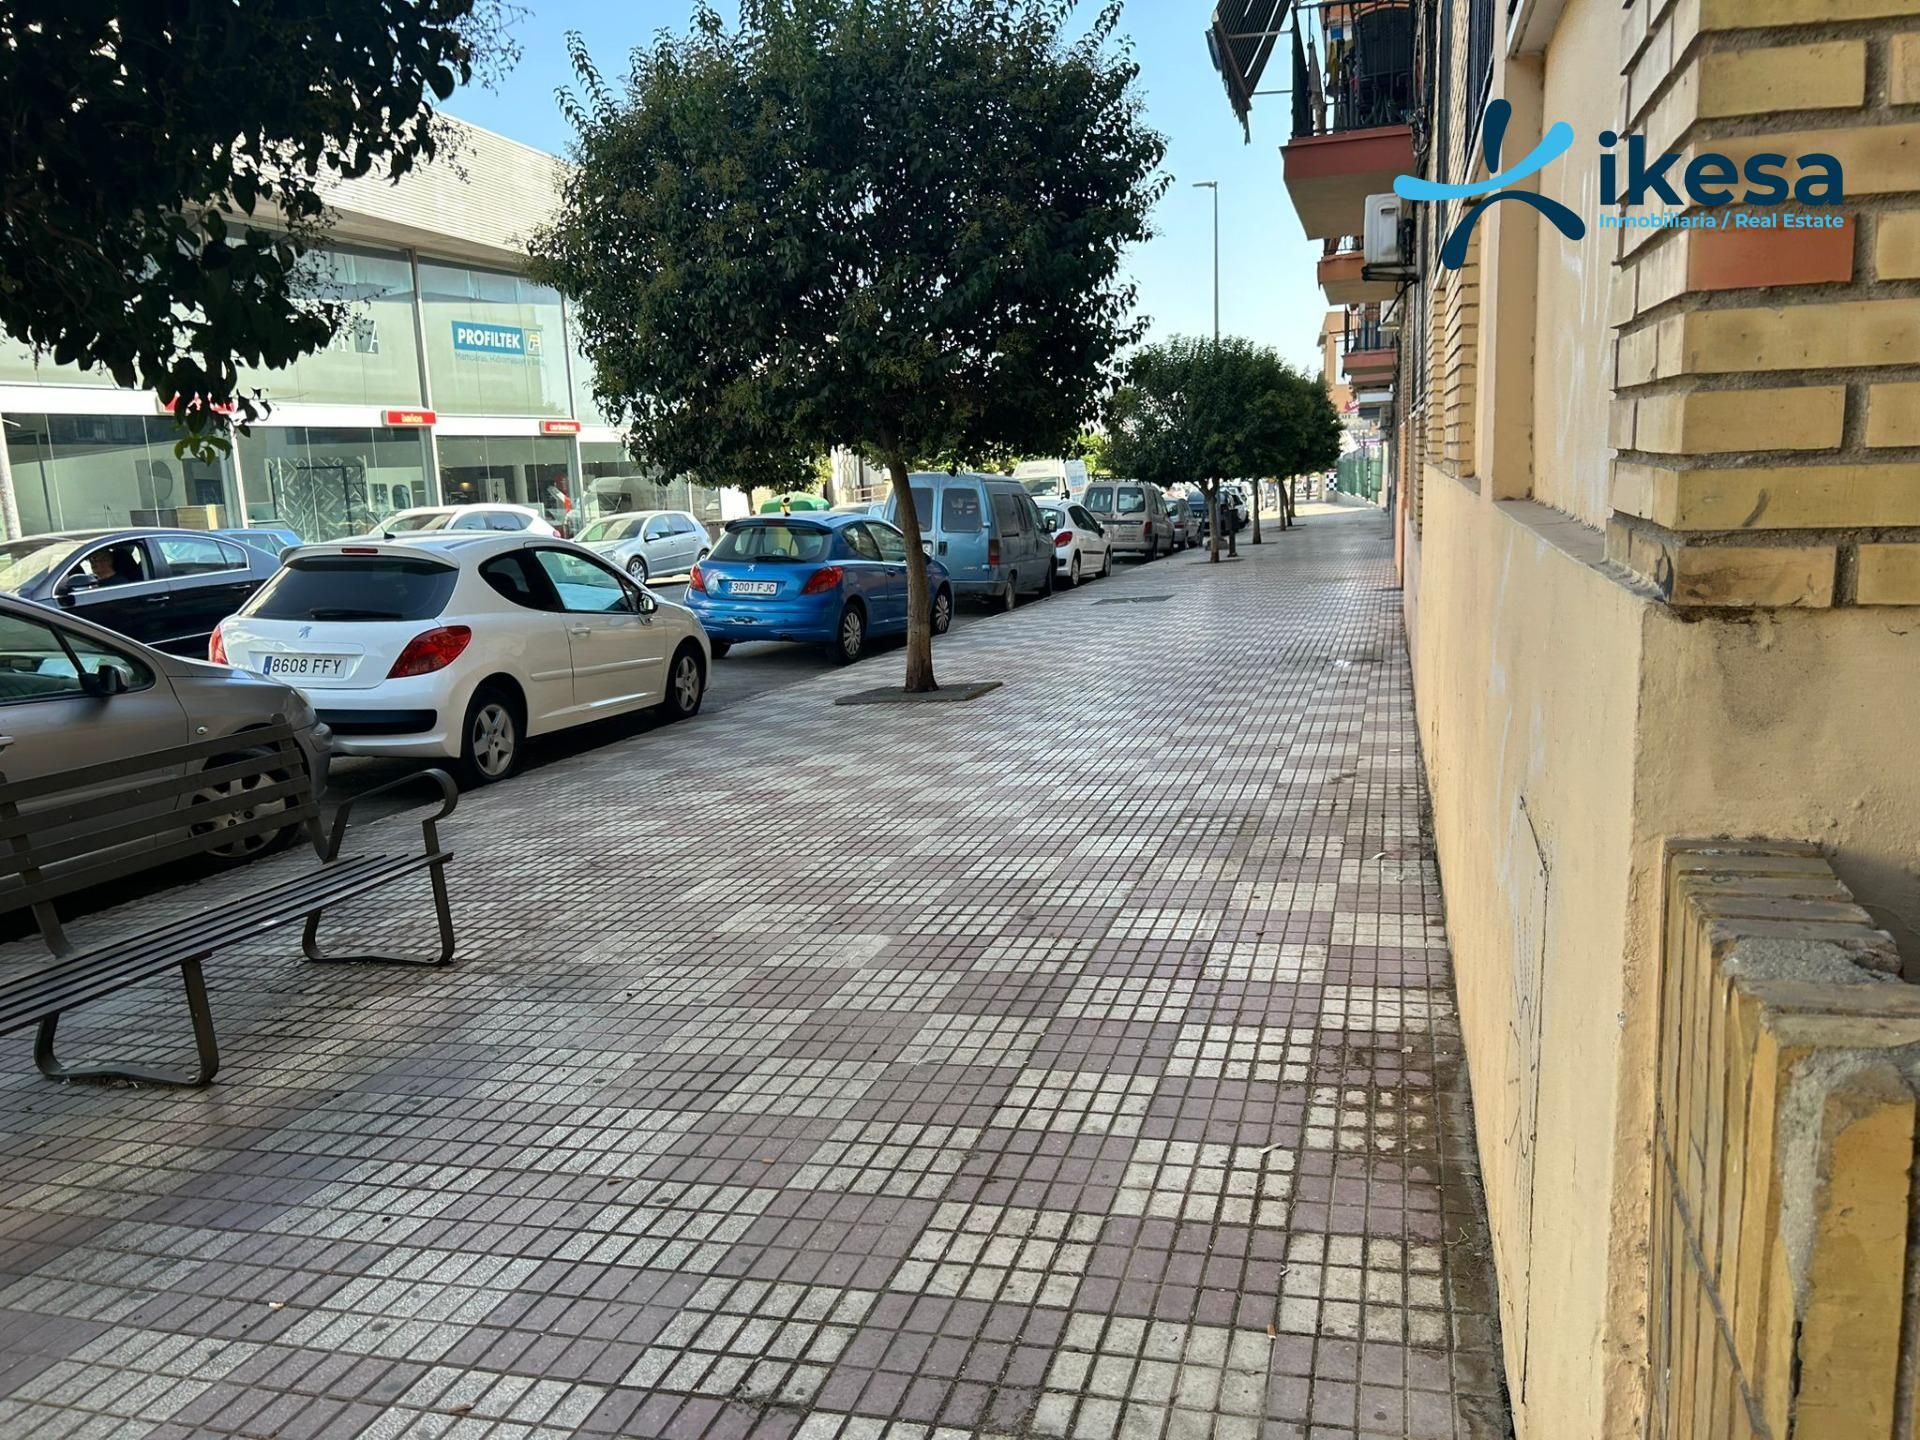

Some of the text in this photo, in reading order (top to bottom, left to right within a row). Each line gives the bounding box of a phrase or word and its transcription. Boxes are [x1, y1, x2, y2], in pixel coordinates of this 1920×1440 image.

[458, 328, 521, 349] PROFILTEK
[733, 582, 775, 593] 3001 FJC
[272, 658, 342, 674] 8608 FFY
